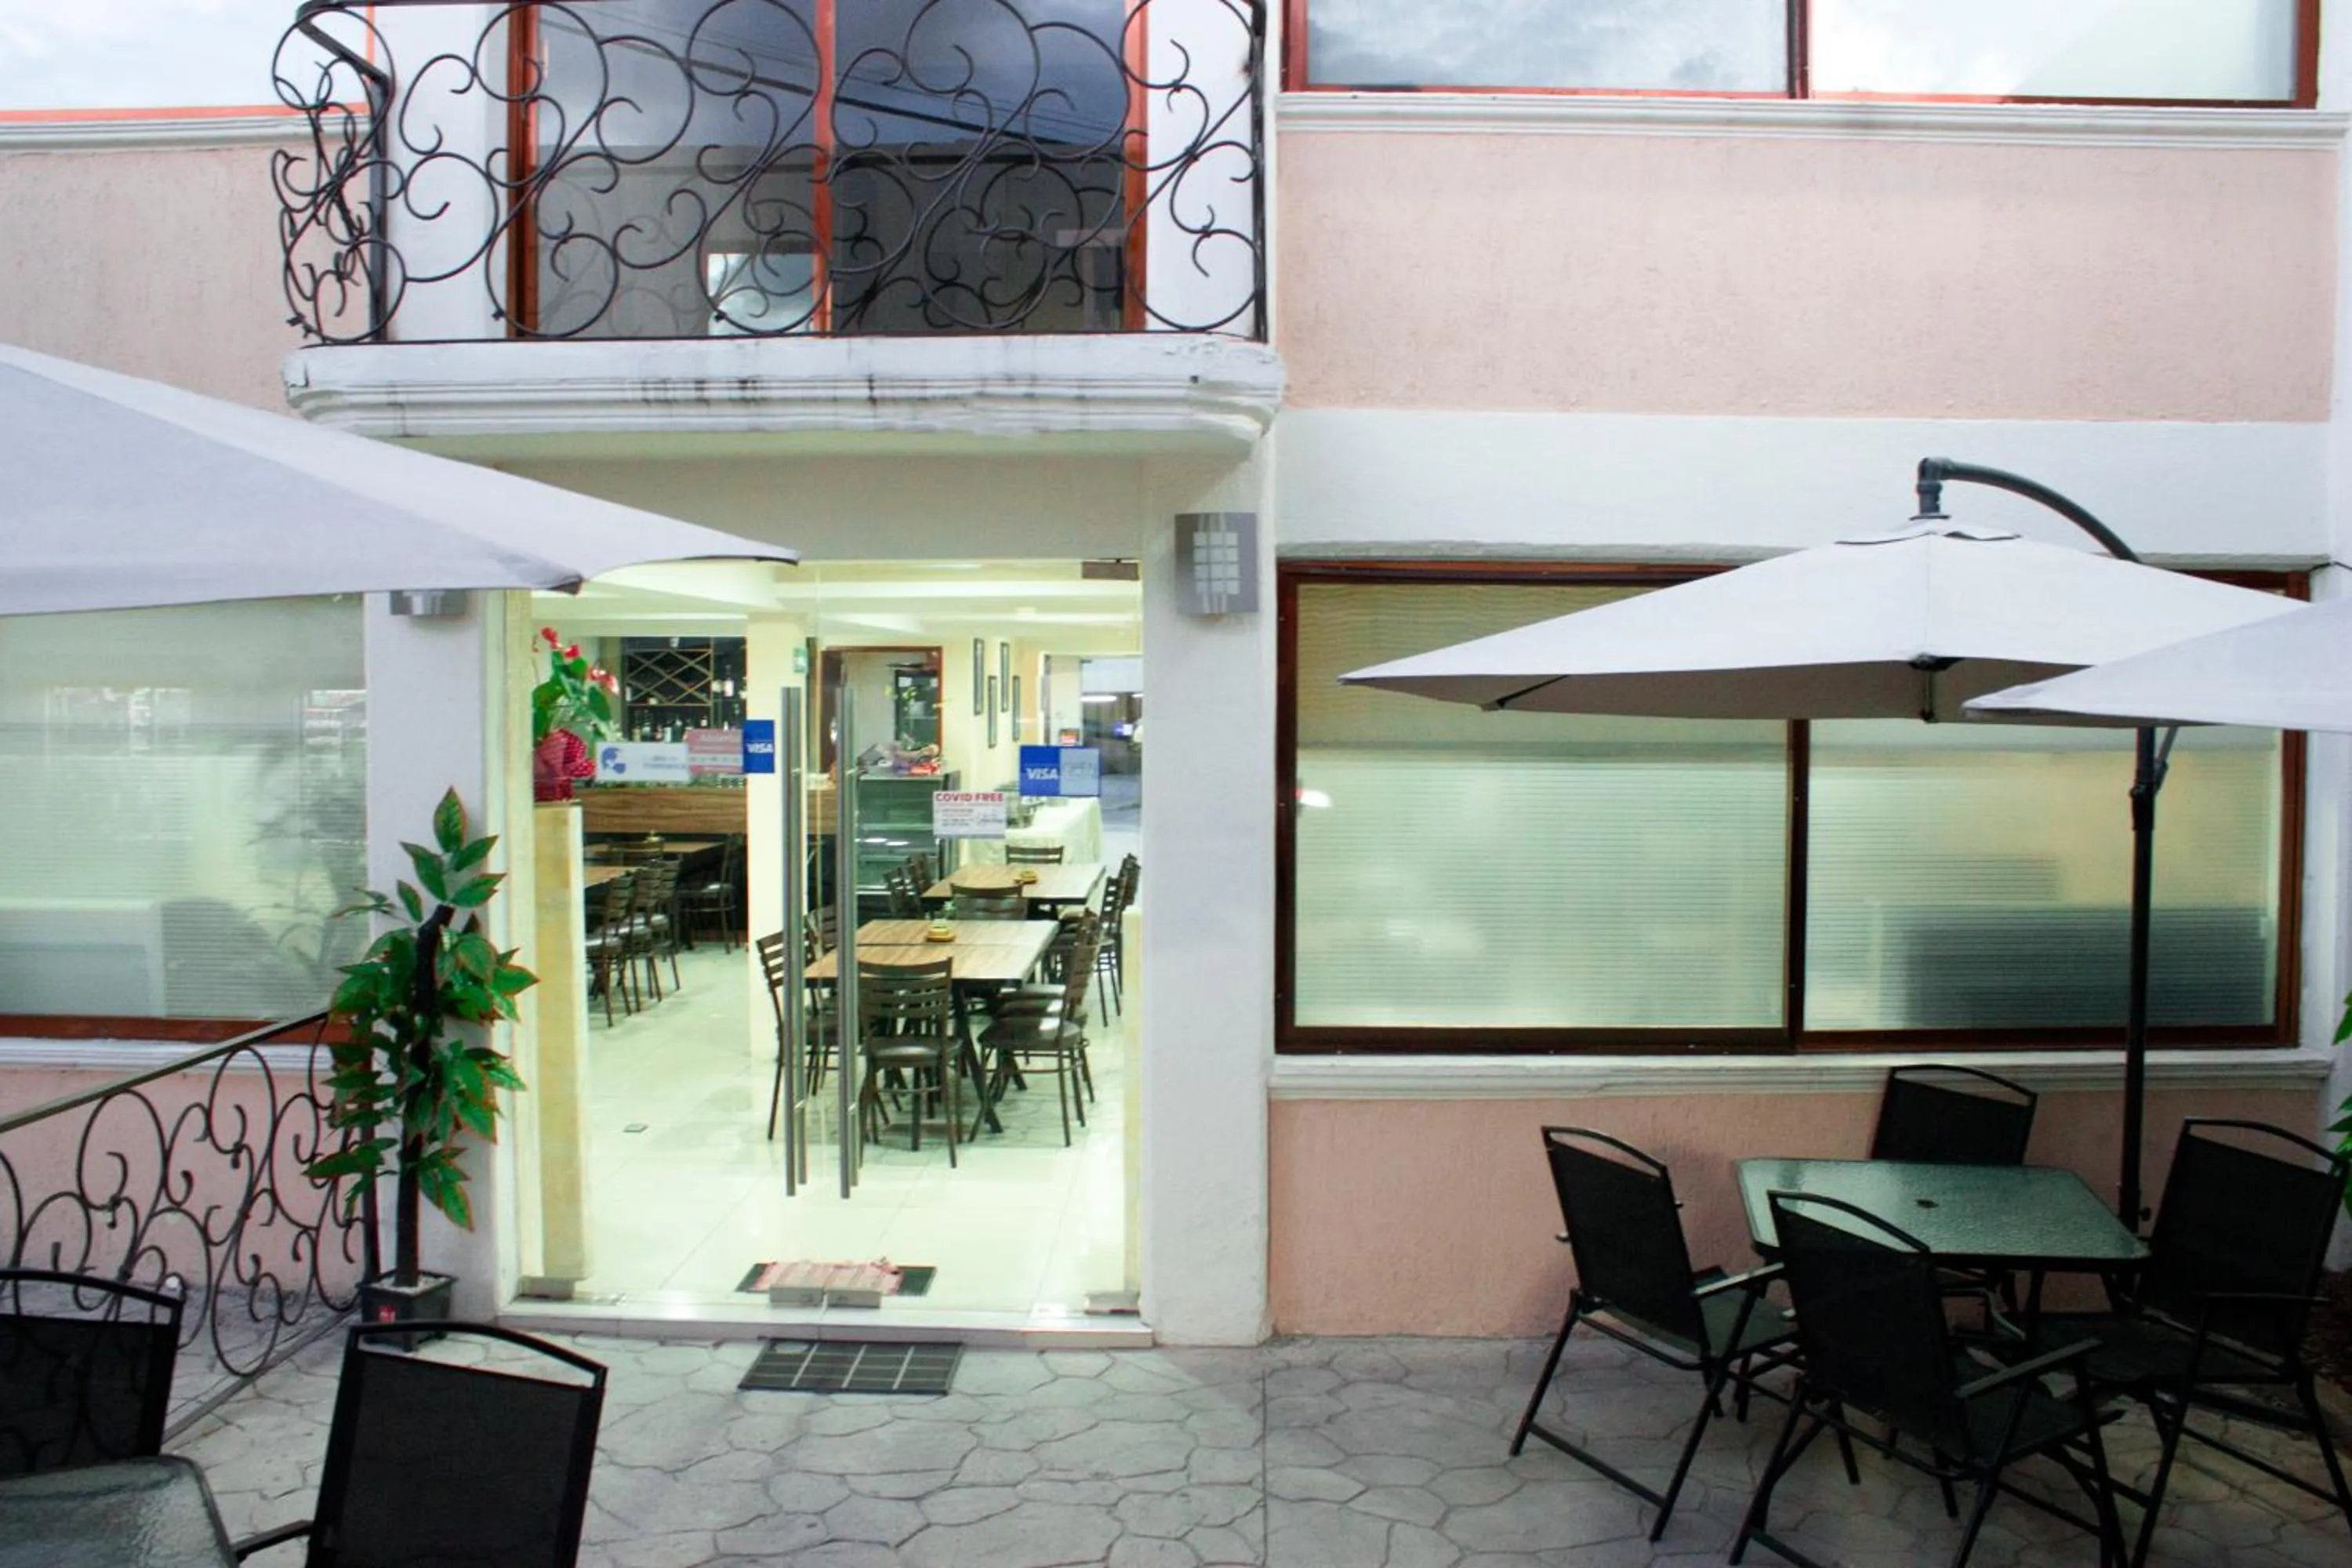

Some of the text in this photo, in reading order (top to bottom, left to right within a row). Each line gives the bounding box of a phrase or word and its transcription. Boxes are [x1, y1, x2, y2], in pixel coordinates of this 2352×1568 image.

[746, 742, 773, 753] VISA
[1025, 768, 1058, 780] VISA
[936, 793, 1004, 801] COVID FREE
